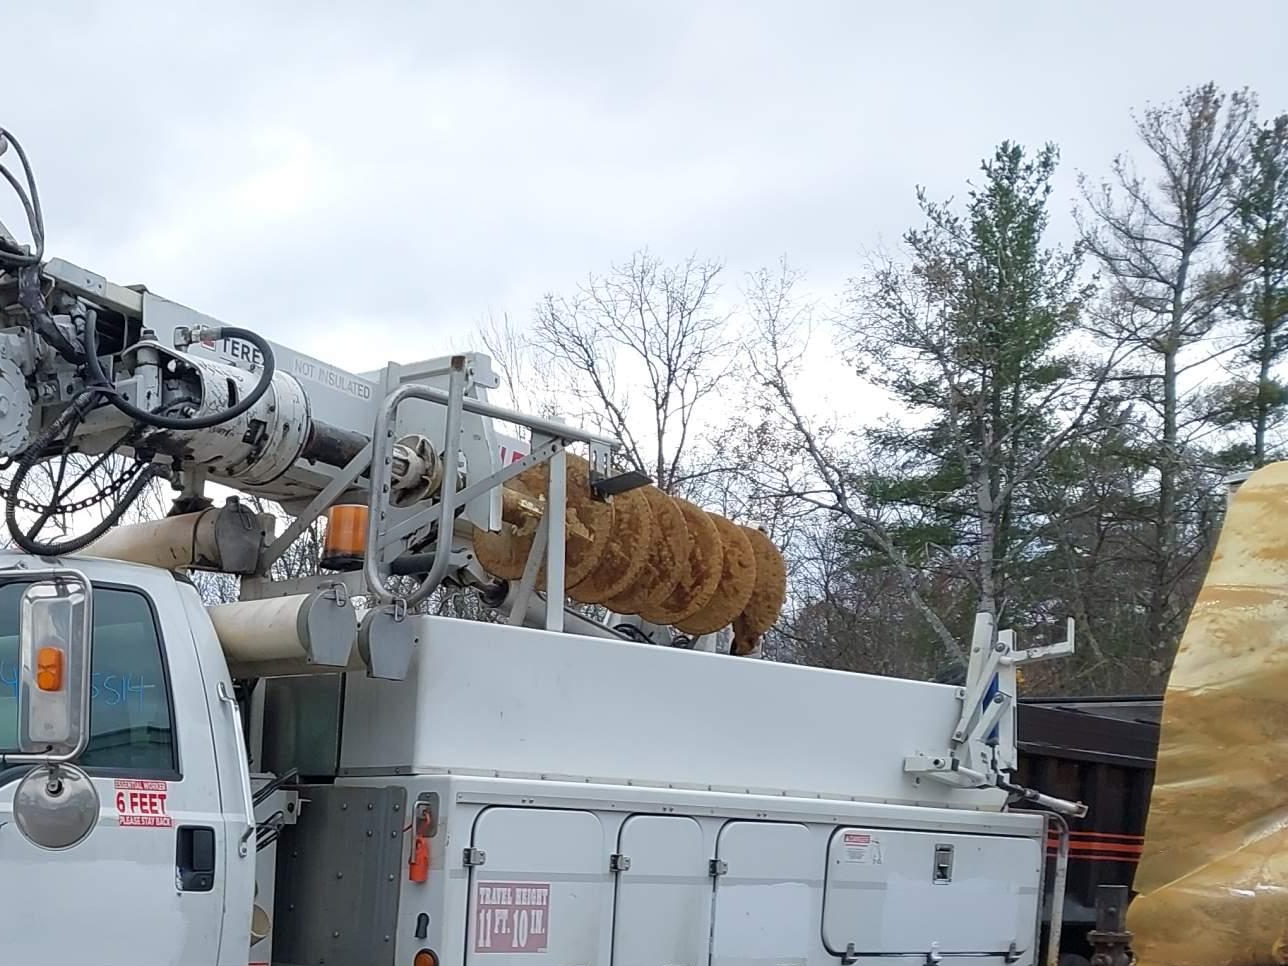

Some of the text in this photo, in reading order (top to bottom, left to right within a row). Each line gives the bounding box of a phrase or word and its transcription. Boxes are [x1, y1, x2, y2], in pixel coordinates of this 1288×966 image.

[221, 338, 265, 365] TERE
[294, 359, 371, 400] NOT INSULATED
[116, 791, 167, 815] 6 FEET
[119, 816, 142, 825] PLEASE
[142, 817, 155, 826] STAY
[479, 887, 548, 906] TRAVEL HEIGHT
[478, 908, 545, 948] 11 FT. 10 IN.
